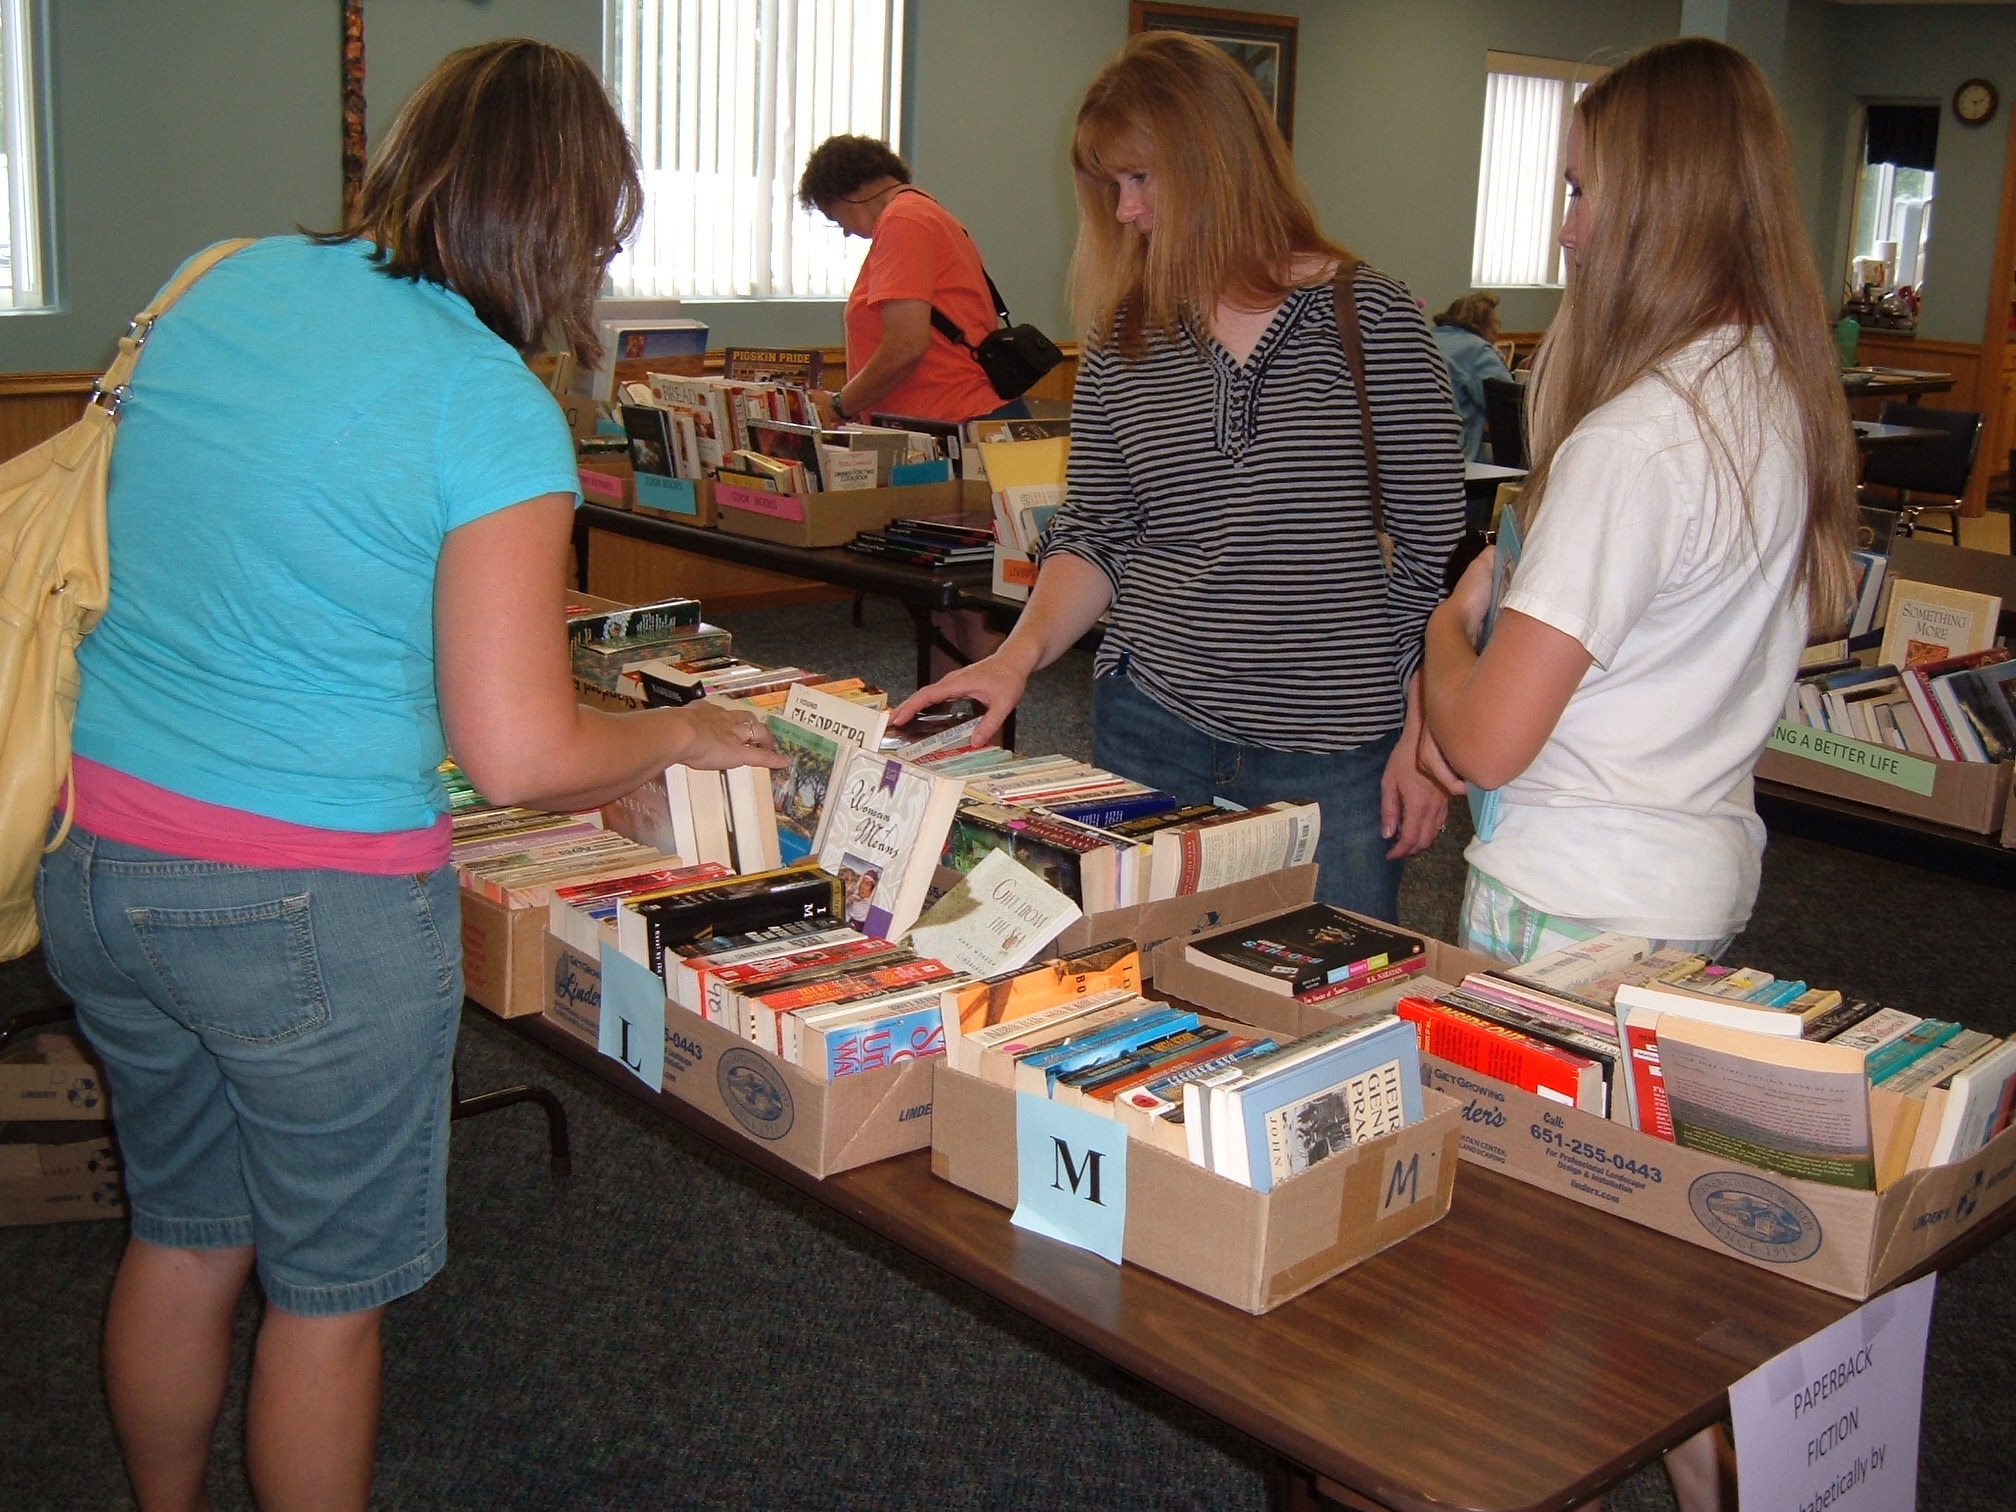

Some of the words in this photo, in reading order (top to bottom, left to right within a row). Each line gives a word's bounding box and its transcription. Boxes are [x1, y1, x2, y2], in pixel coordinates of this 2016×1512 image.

[733, 350, 776, 363] PIGSKIN
[779, 353, 810, 364] PRIDE
[1902, 603, 1968, 629] SOMETHING
[1914, 620, 1949, 641] MORE
[1800, 735, 1811, 749] A
[1814, 737, 1865, 766] BETTER
[1869, 752, 1899, 775] LIFE
[850, 779, 891, 822] Woman
[618, 1014, 642, 1073] L
[1461, 1098, 1507, 1128] der's
[1269, 1116, 1283, 1166] JOHN
[1530, 1124, 1663, 1183] 651-255-0443
[1049, 1135, 1107, 1207] M
[1384, 1152, 1419, 1209] M
[1793, 1344, 1873, 1420] PAPERBACK
[1806, 1407, 1859, 1467] FICTION
[1871, 1443, 1887, 1470] by
